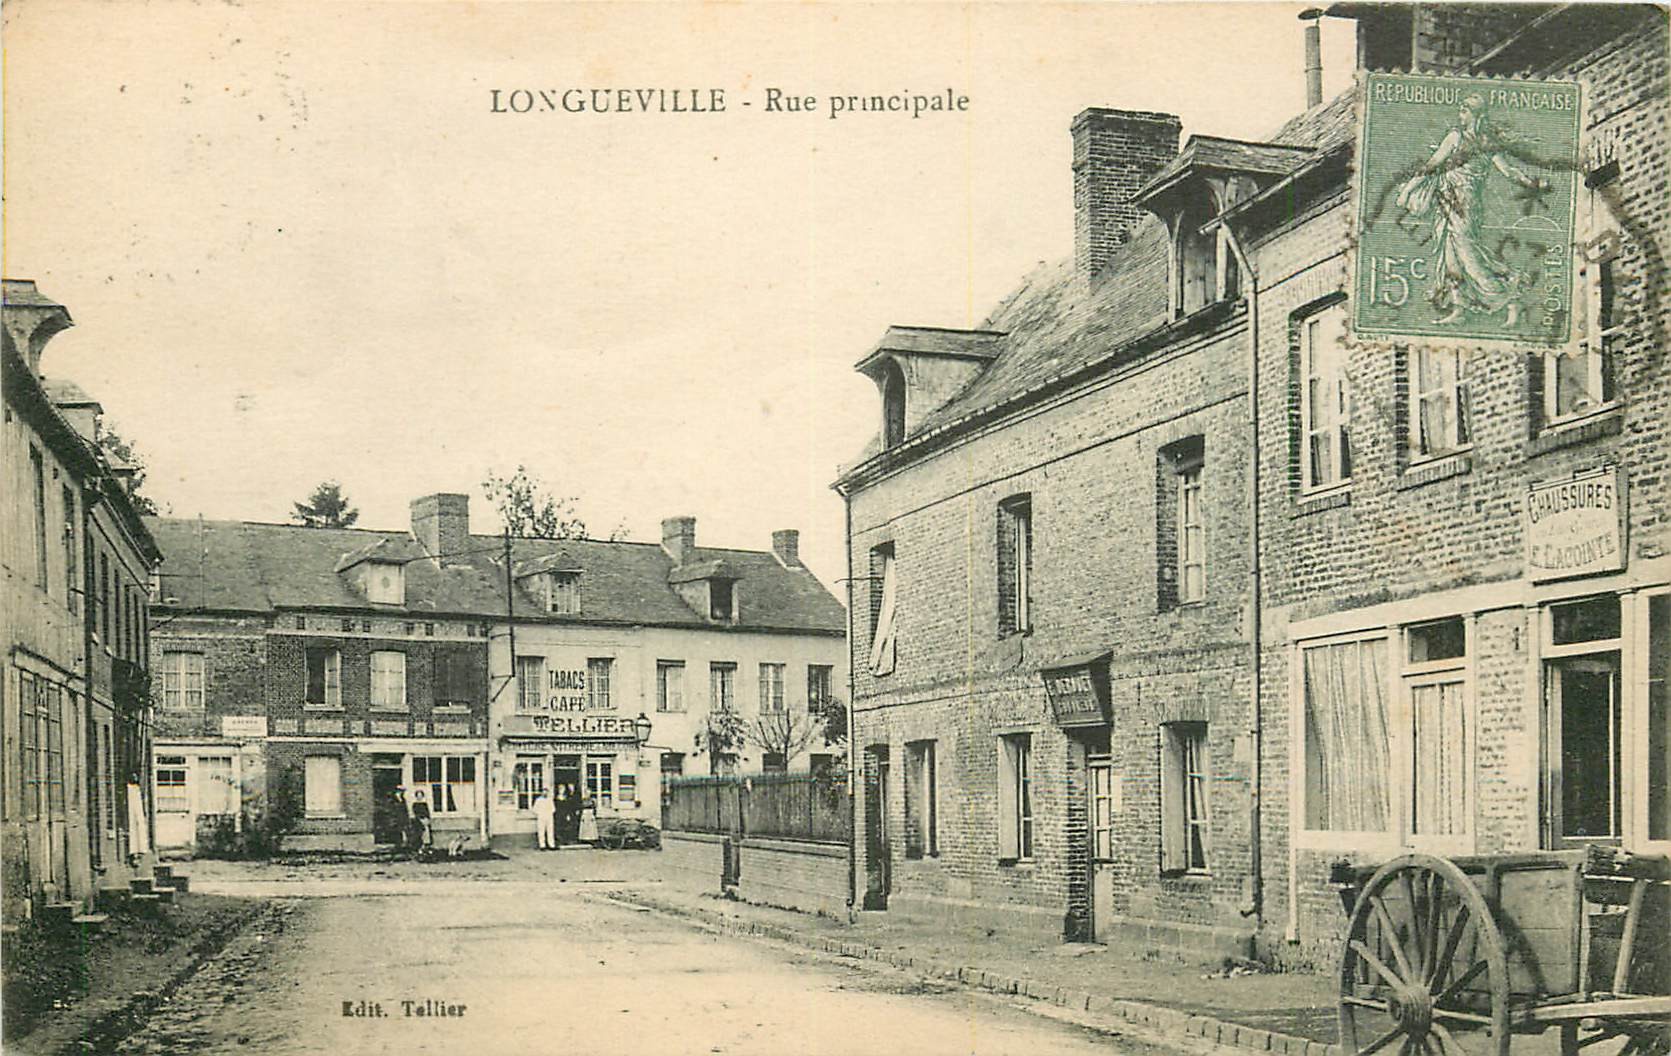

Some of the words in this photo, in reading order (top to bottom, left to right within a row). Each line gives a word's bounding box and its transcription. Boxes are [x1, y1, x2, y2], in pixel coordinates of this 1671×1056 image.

[1543, 243, 1564, 327] POSTES
[548, 670, 585, 690] TABACS
[533, 715, 635, 733] TELLIER
